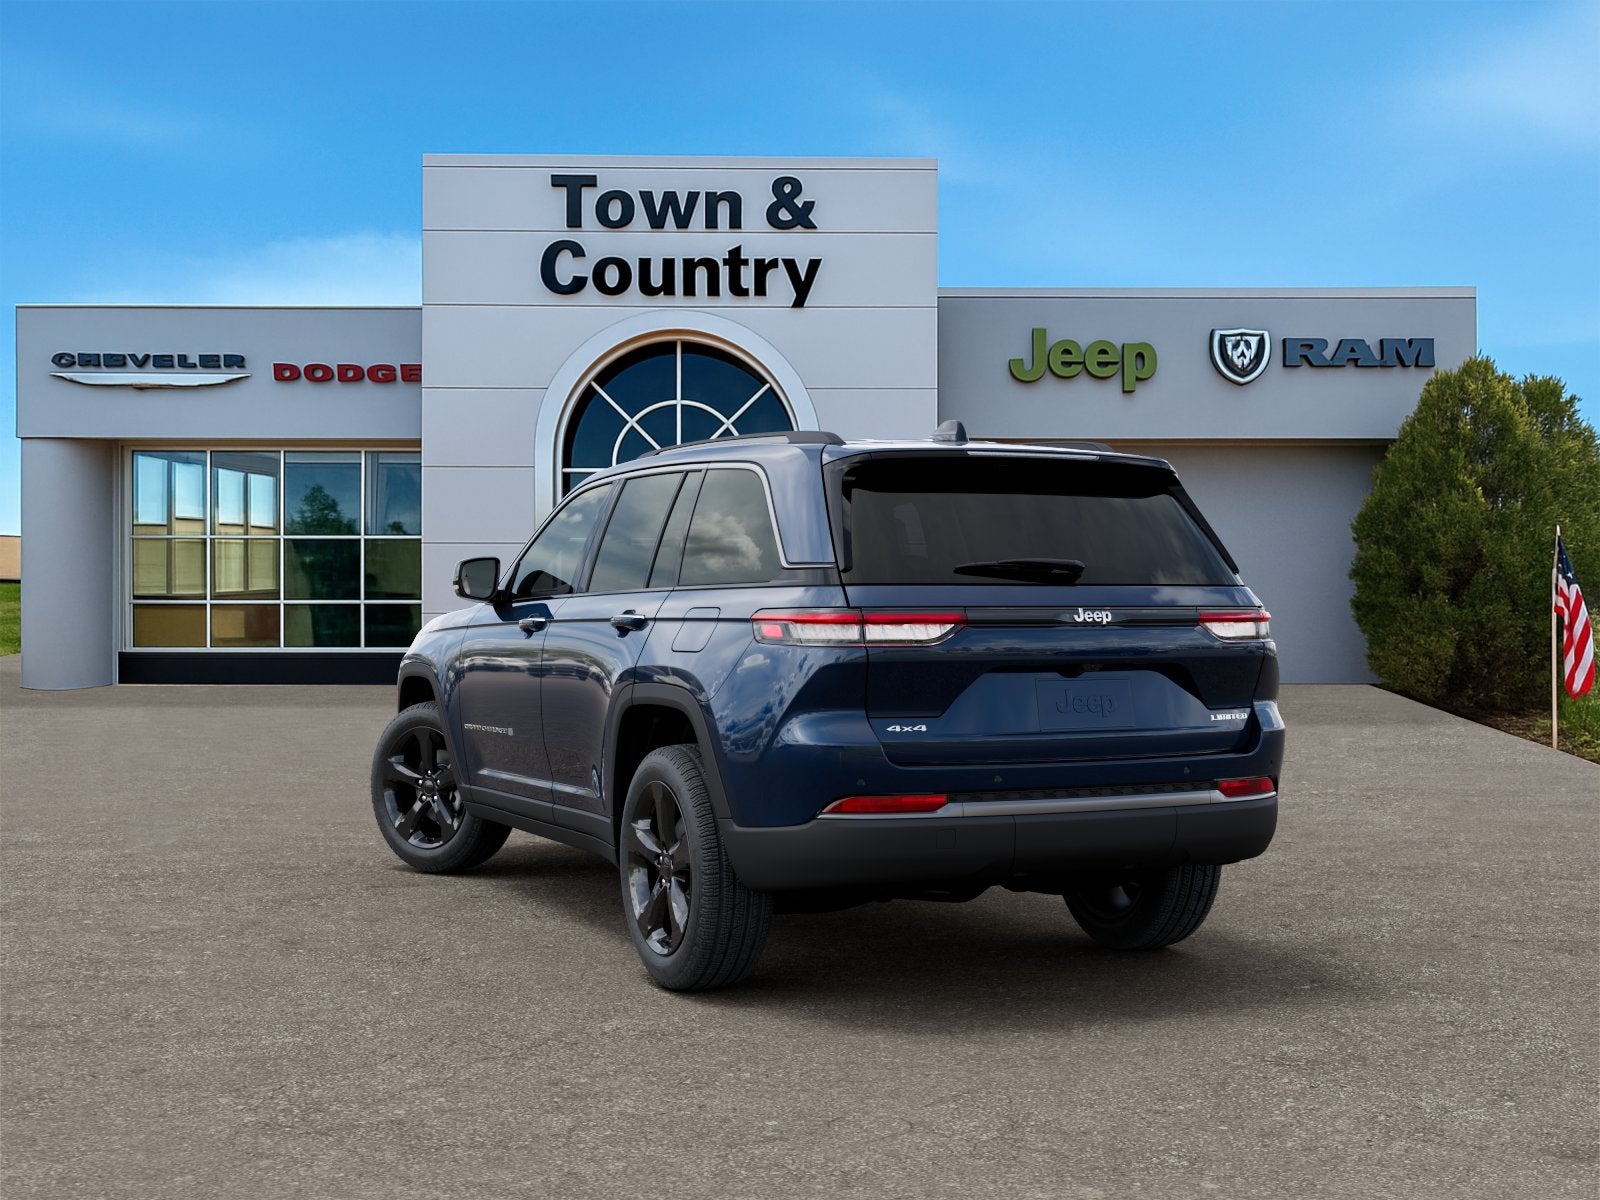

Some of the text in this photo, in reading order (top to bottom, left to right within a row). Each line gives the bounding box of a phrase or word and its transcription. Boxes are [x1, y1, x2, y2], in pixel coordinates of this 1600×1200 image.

[551, 174, 818, 230] Town &
[540, 239, 822, 308] Country
[1008, 328, 1157, 393] Jeep
[1282, 338, 1436, 367] RAM
[273, 363, 422, 383] DODGE
[1074, 608, 1112, 624] Jeep
[1056, 688, 1117, 718] Jeep
[886, 724, 928, 732] 4x4
